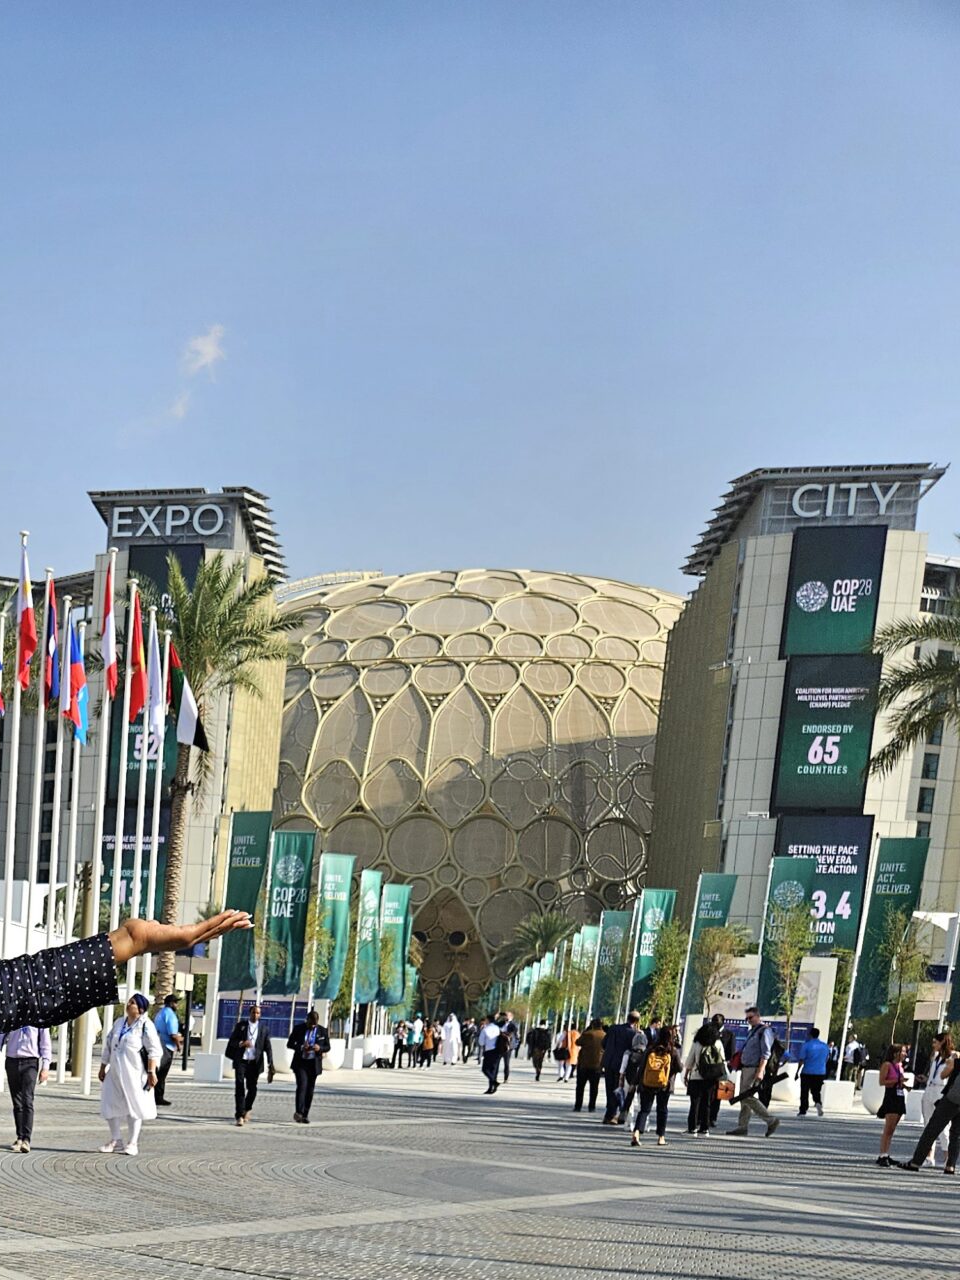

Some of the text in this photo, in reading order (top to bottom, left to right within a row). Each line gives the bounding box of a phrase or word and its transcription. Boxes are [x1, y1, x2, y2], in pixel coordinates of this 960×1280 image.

[792, 481, 901, 518] CITY
[111, 503, 224, 538] EXPO
[832, 579, 873, 596] COP28
[830, 595, 858, 612] UAE
[802, 724, 854, 734] ENDORSED BY
[807, 735, 841, 765] 65
[797, 765, 848, 774] COUNTRIES
[233, 835, 257, 845] UNITE.
[232, 846, 248, 855] ACT.
[788, 845, 859, 855] SETTING THE PACE
[835, 855, 852, 864] ERA
[827, 864, 858, 874] ACTION
[879, 862, 907, 872] UNITE.
[876, 873, 896, 883] ACT.
[875, 884, 912, 894] DELIVER.
[272, 887, 308, 903] COP28
[809, 890, 852, 919] 3.4
[271, 902, 295, 918] UAE
[641, 932, 658, 944] COP
